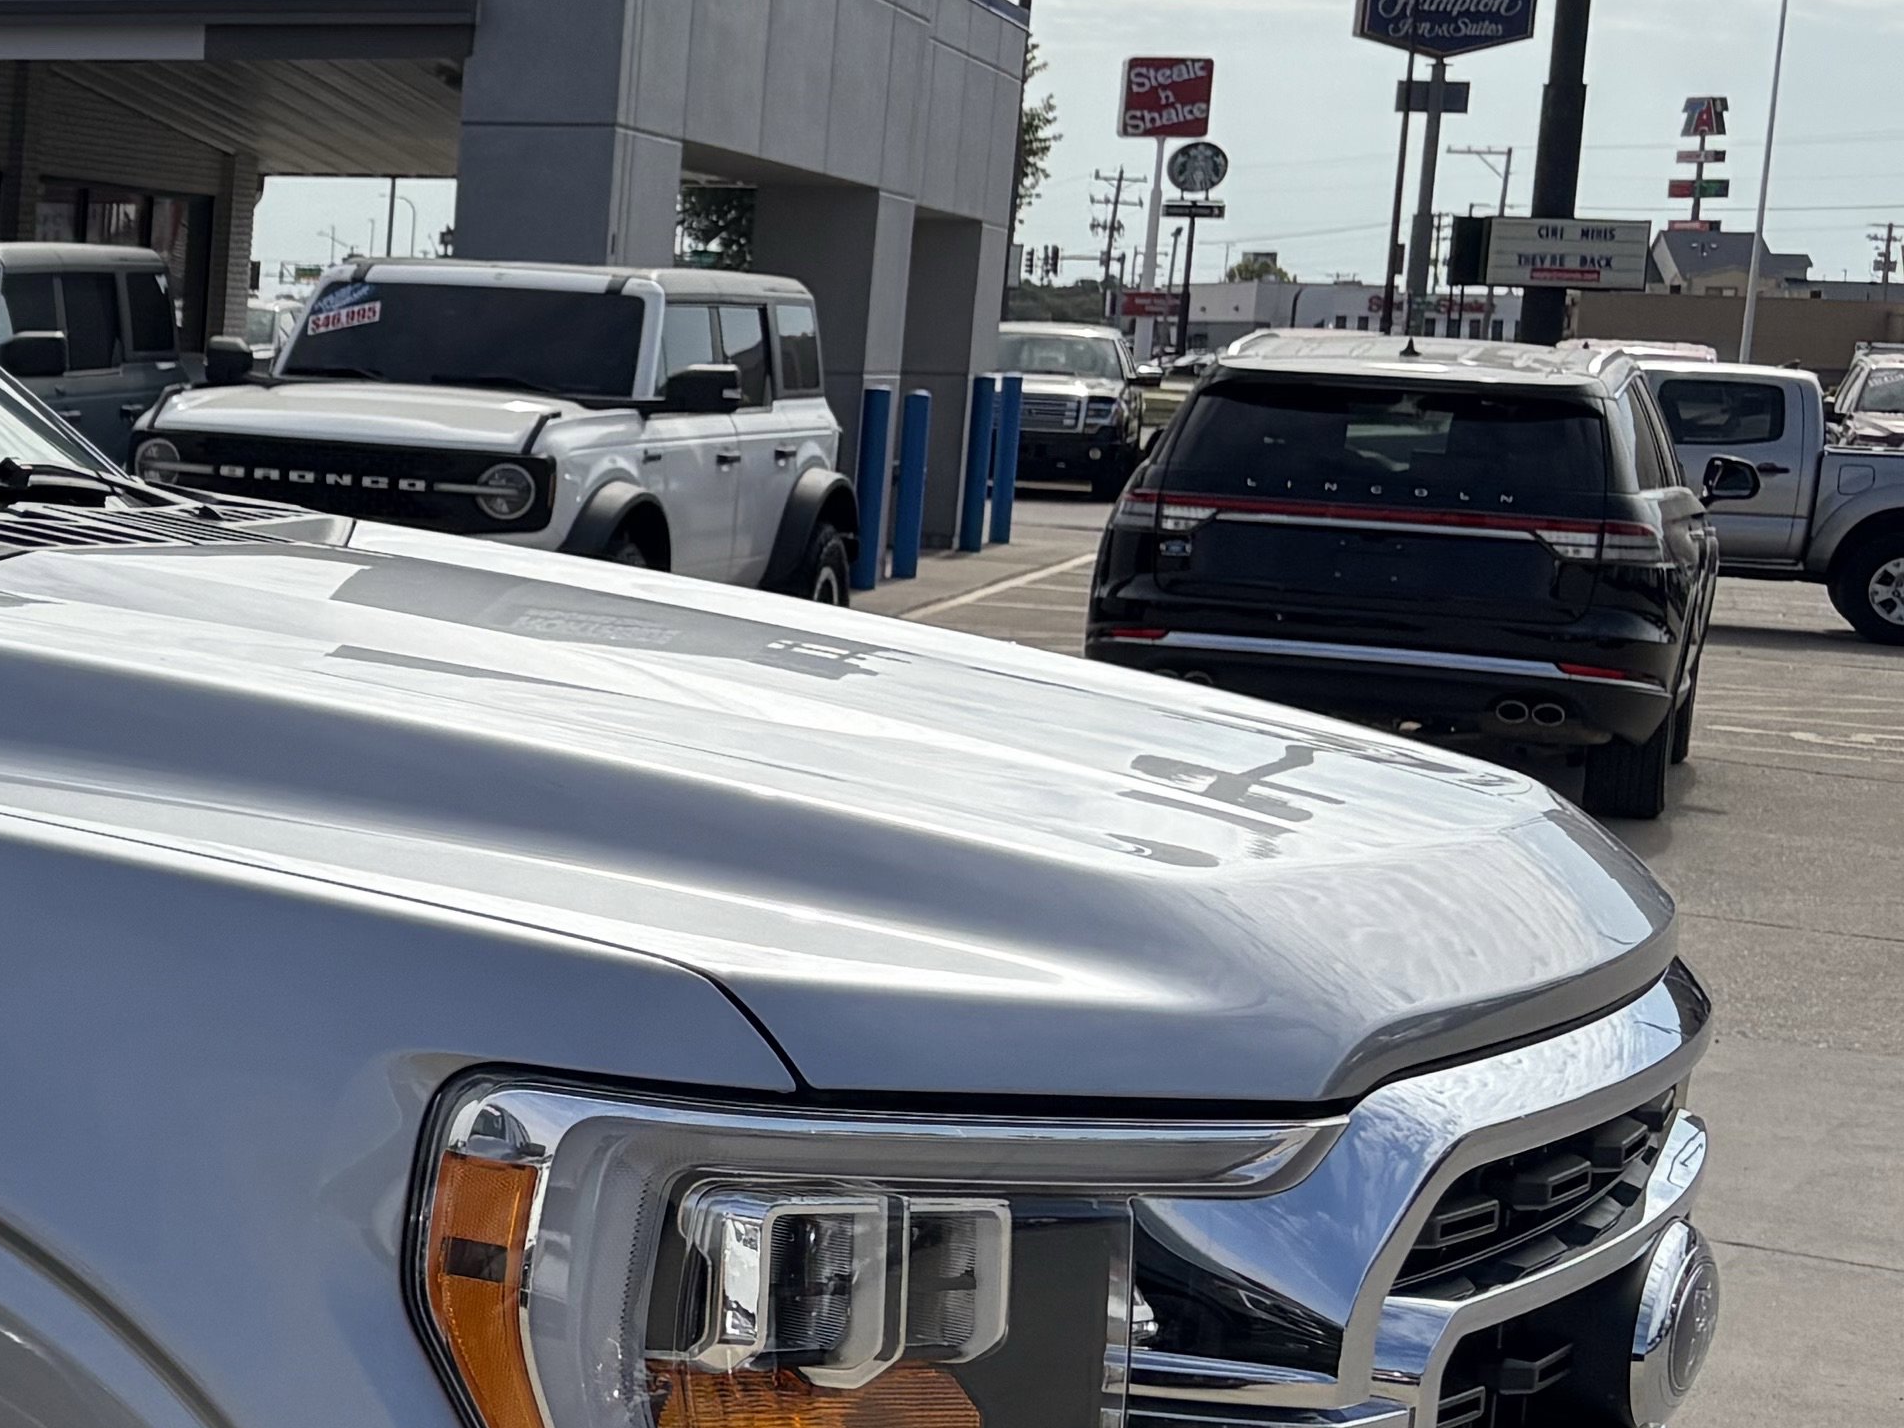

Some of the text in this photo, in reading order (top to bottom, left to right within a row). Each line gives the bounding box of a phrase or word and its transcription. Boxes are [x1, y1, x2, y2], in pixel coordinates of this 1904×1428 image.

[1131, 60, 1207, 93] Steak
[1125, 102, 1208, 134] Shake
[219, 464, 426, 492] BRONCO
[1247, 477, 1513, 504] LINCOLN
